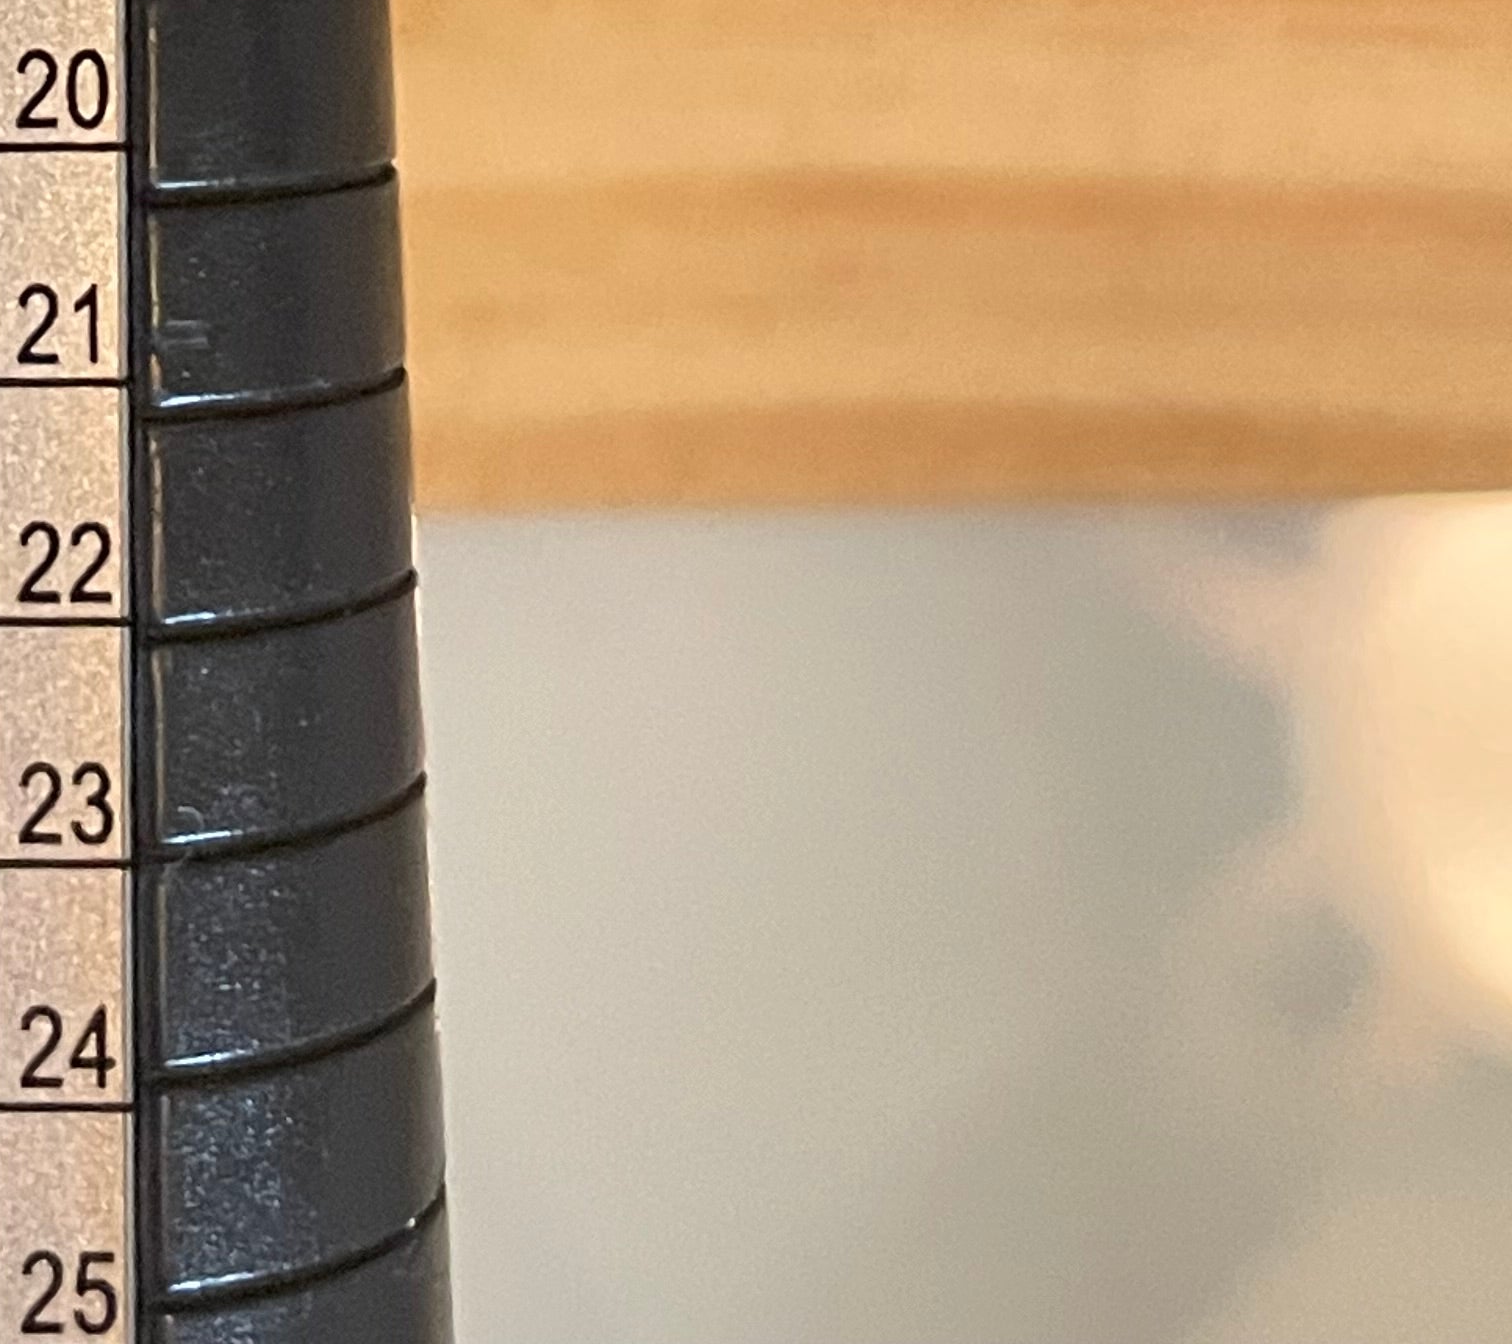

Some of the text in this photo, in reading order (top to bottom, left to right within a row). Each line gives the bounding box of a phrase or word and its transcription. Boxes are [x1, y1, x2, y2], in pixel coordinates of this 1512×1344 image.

[14, 49, 110, 130] 20
[16, 282, 101, 365] 21
[16, 520, 114, 604] 22
[17, 762, 115, 845] 23
[19, 1004, 116, 1090] 24
[19, 1250, 119, 1335] 25
